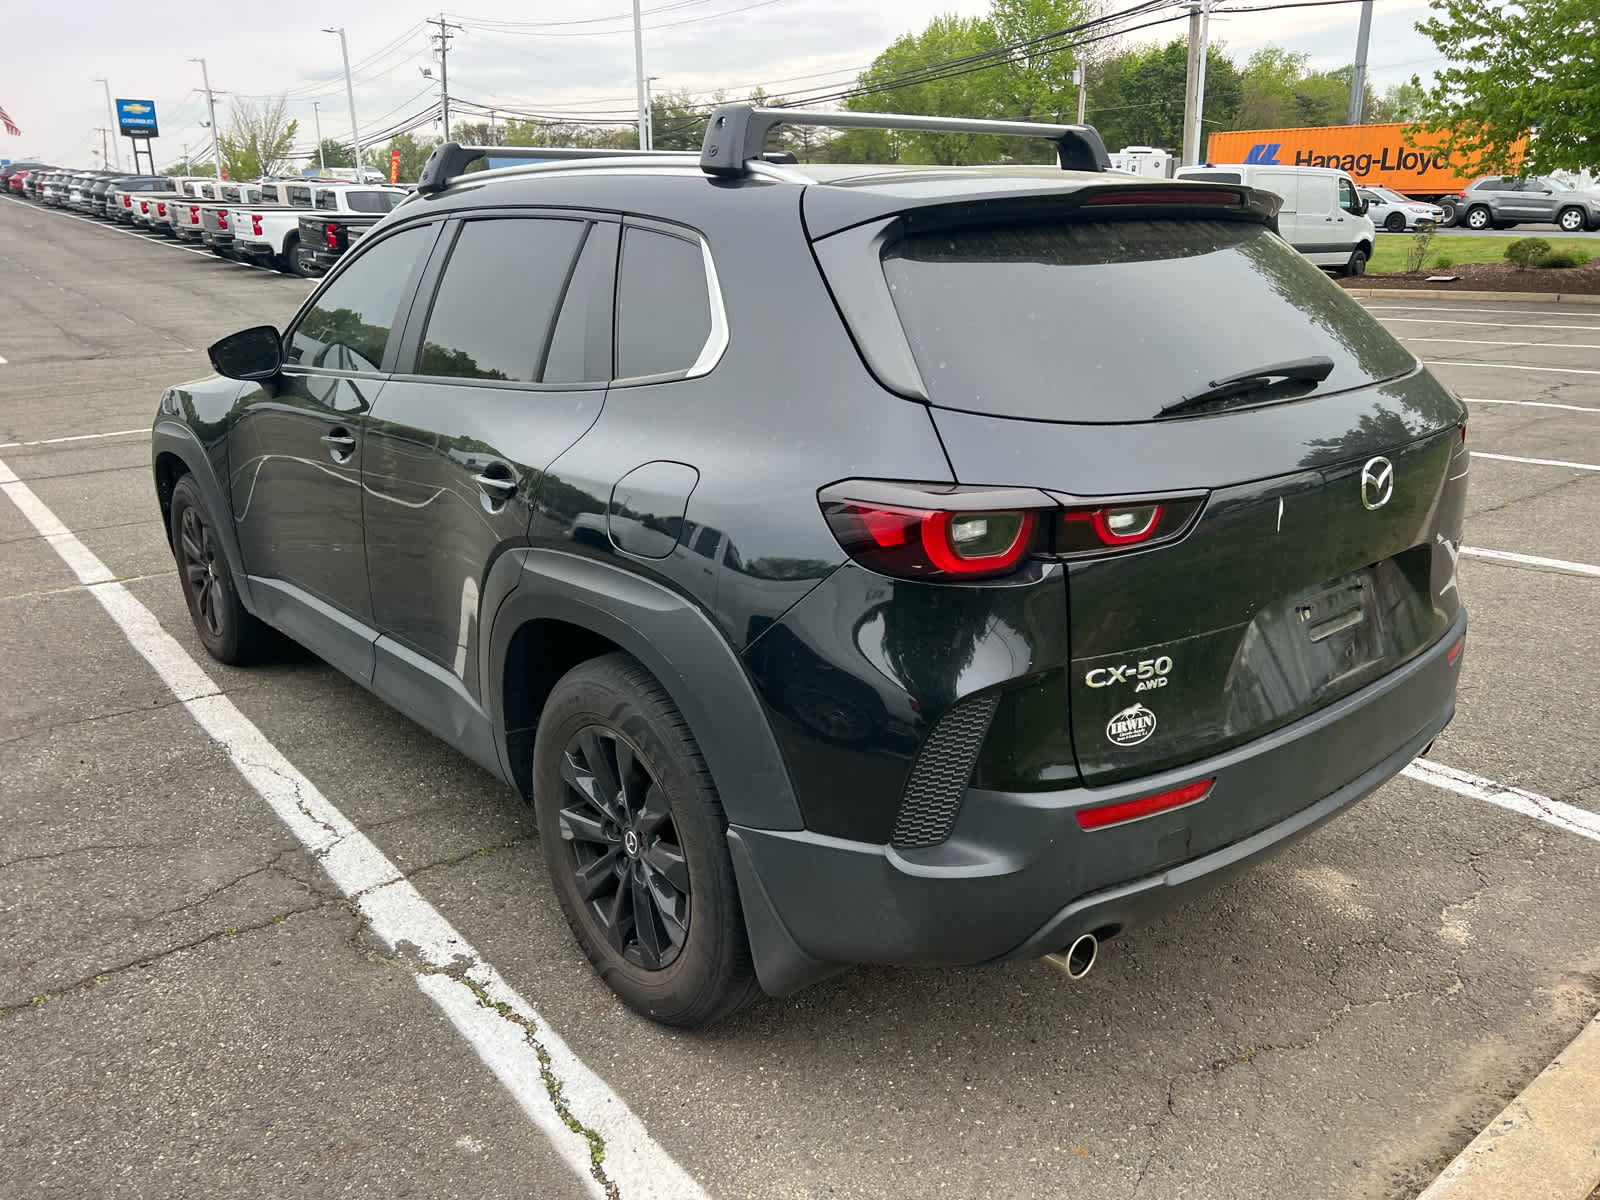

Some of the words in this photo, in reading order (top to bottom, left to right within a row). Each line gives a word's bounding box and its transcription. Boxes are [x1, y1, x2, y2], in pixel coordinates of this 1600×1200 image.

[1085, 656, 1173, 688] CX-50
[1134, 676, 1168, 693] AWD
[1111, 715, 1152, 735] IRWIN
